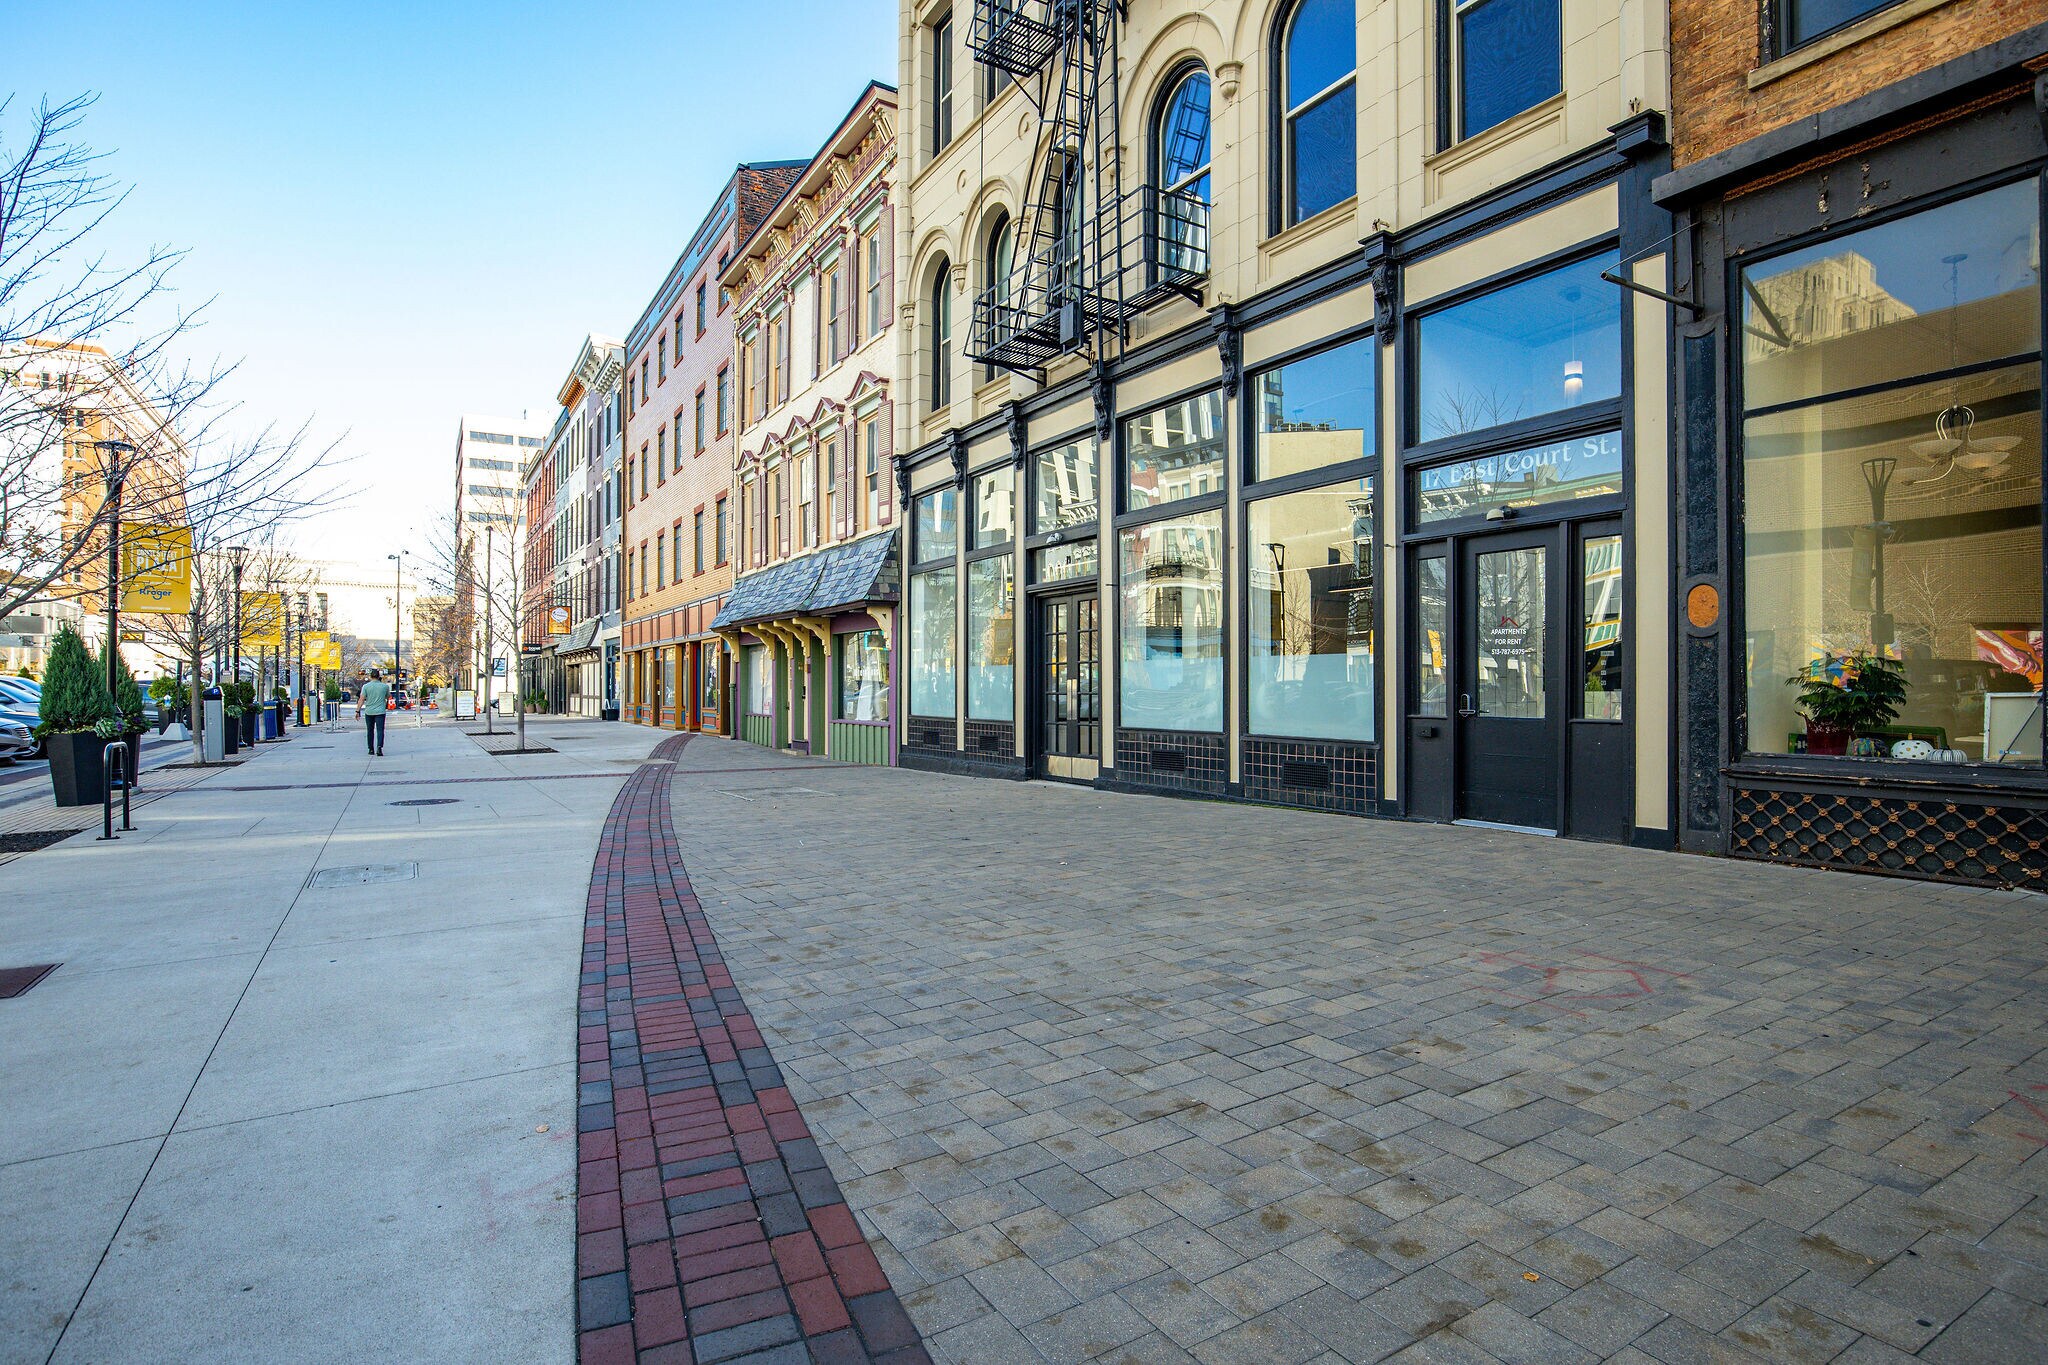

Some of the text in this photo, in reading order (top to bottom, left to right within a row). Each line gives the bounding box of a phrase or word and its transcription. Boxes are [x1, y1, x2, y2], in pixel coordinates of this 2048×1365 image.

[1425, 436, 1617, 489] 17 East Court St.
[139, 585, 172, 601] Kroger
